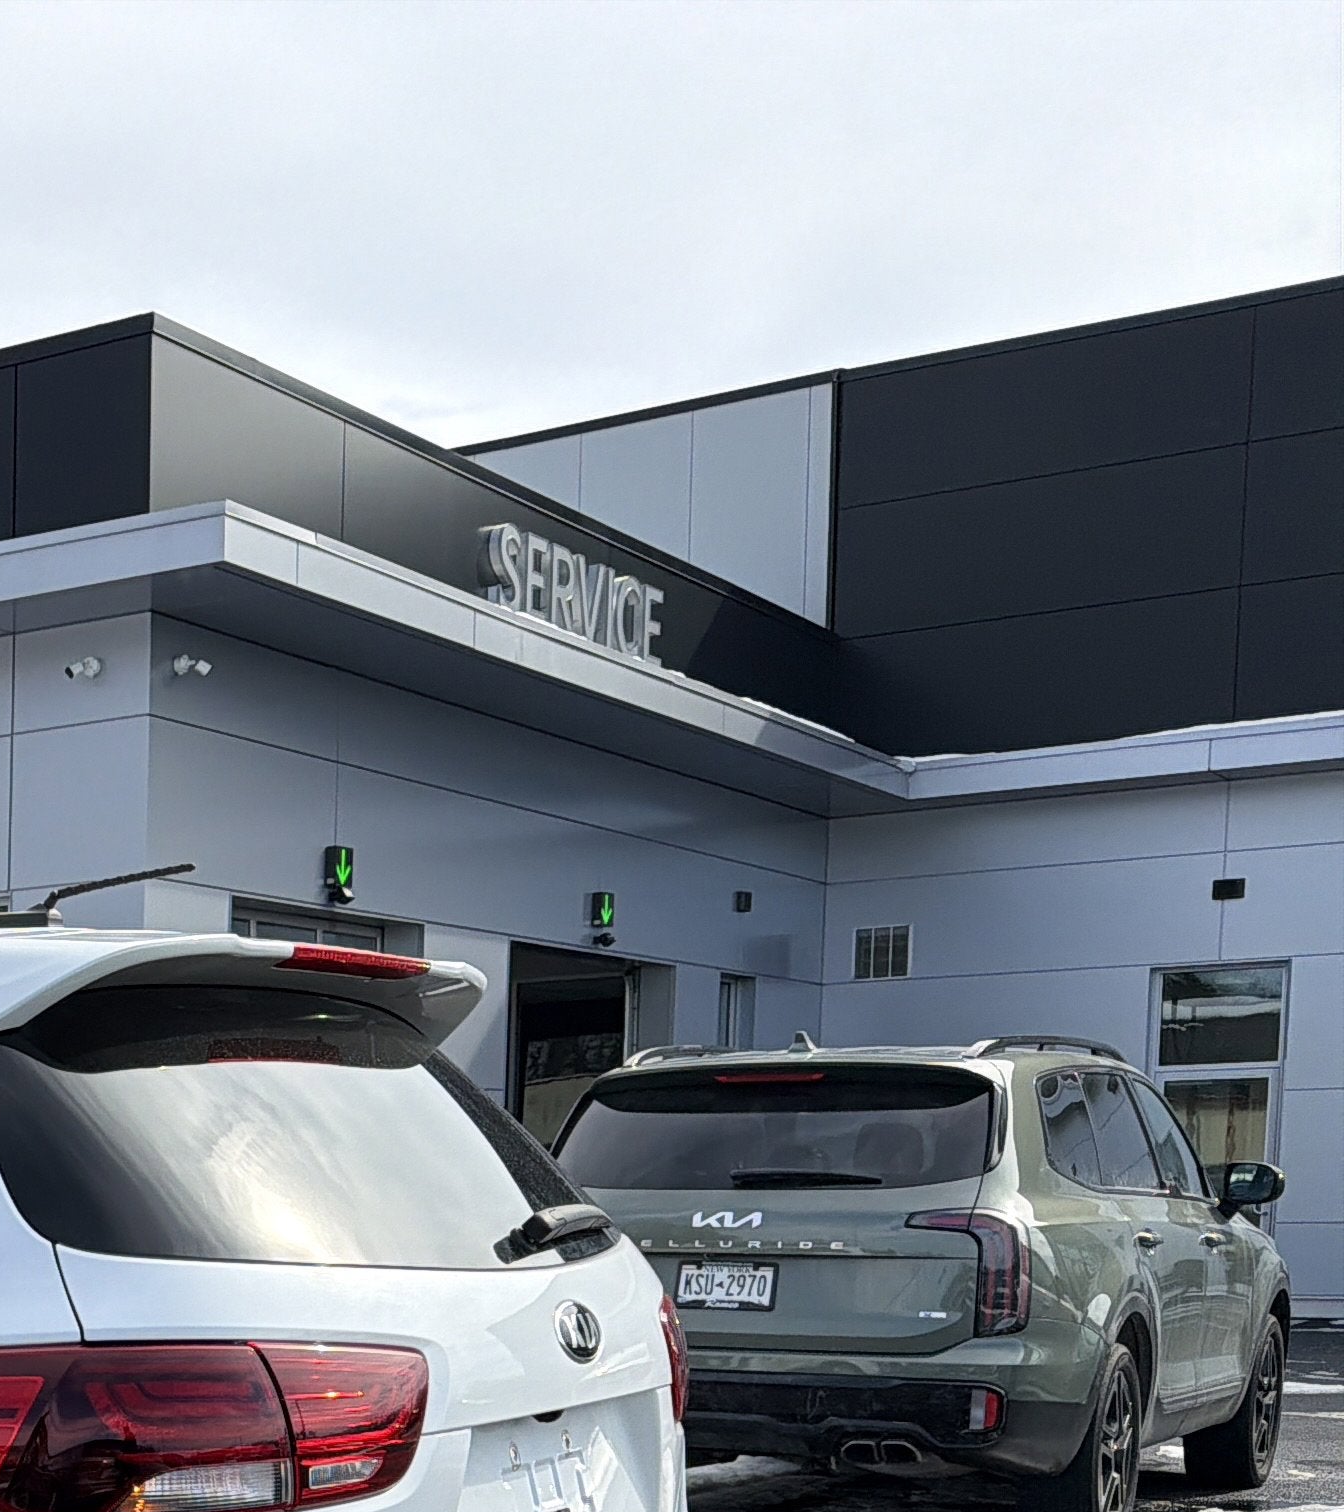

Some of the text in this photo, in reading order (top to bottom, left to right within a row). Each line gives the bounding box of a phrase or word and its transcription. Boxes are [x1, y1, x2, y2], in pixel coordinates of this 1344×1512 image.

[488, 522, 664, 668] SERVICE
[691, 1211, 763, 1229] KIA
[640, 1238, 845, 1250] ELLURIDE
[703, 1265, 751, 1274] NEW YORK
[683, 1273, 767, 1297] KSU 2970
[561, 1313, 597, 1349] KIA
